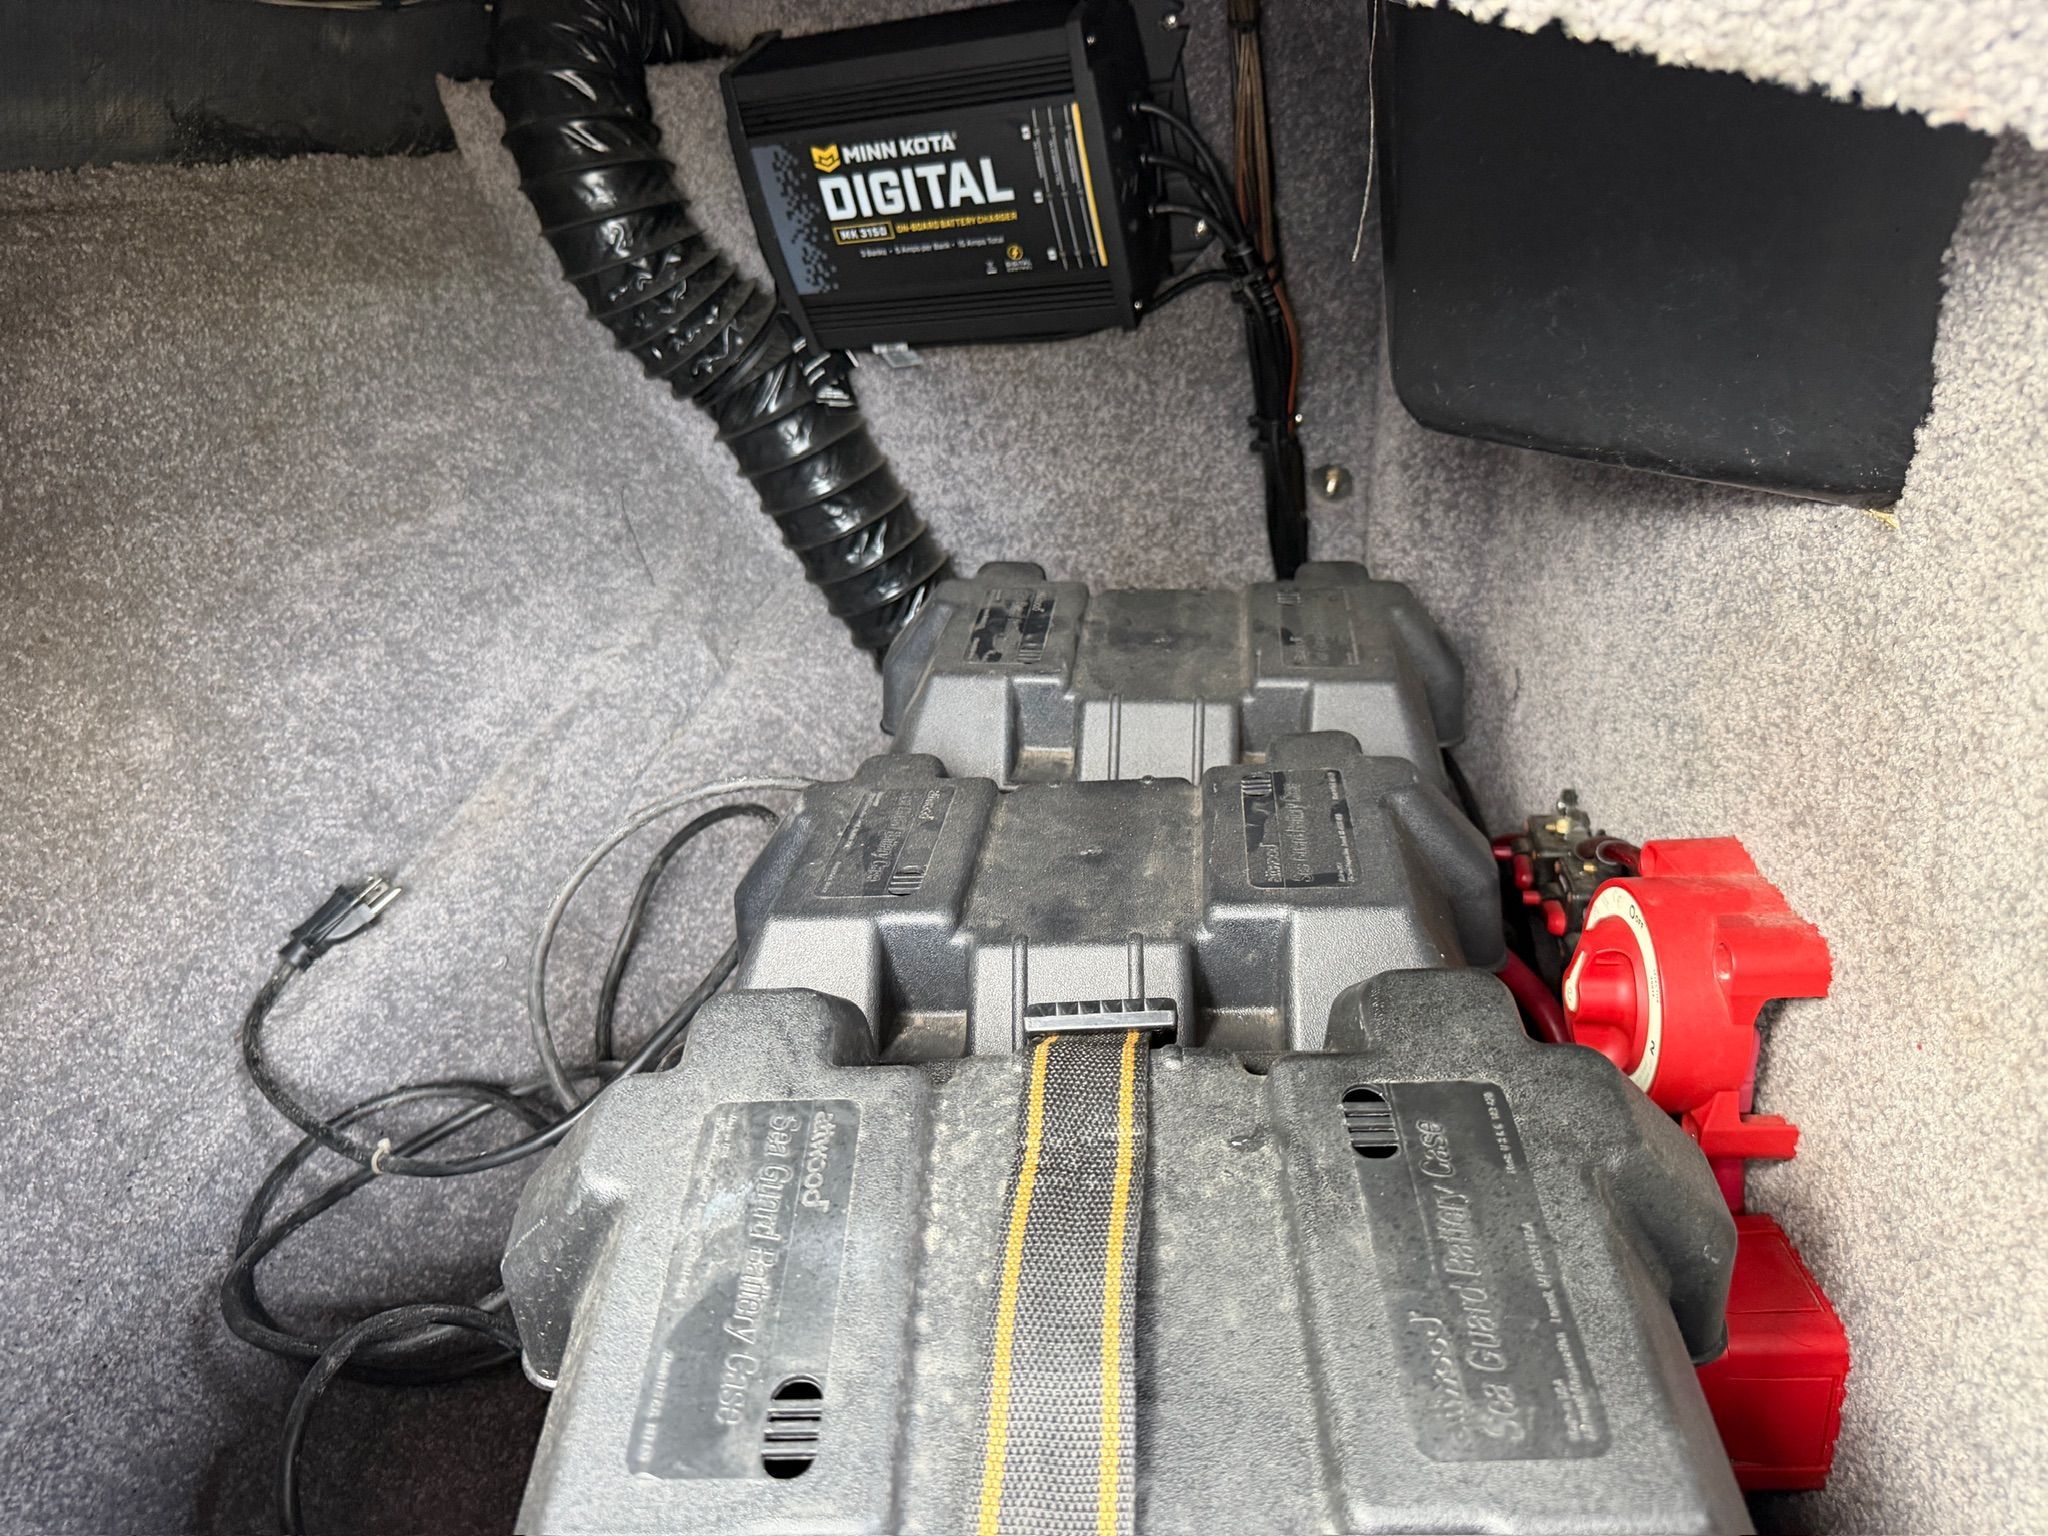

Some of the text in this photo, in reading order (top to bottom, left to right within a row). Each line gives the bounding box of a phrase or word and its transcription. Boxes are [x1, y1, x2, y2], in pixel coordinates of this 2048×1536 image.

[842, 133, 956, 165] MINN KOTA
[818, 158, 1015, 221] DIGITAL
[939, 215, 976, 230] BATTERY
[976, 210, 1018, 224] CHARGER
[839, 228, 858, 241] MK
[1415, 1119, 1456, 1179] Case
[1433, 1184, 1483, 1278] Battery
[714, 1113, 801, 1426] Sea Guard Battery Case
[1449, 1283, 1507, 1373] Guard
